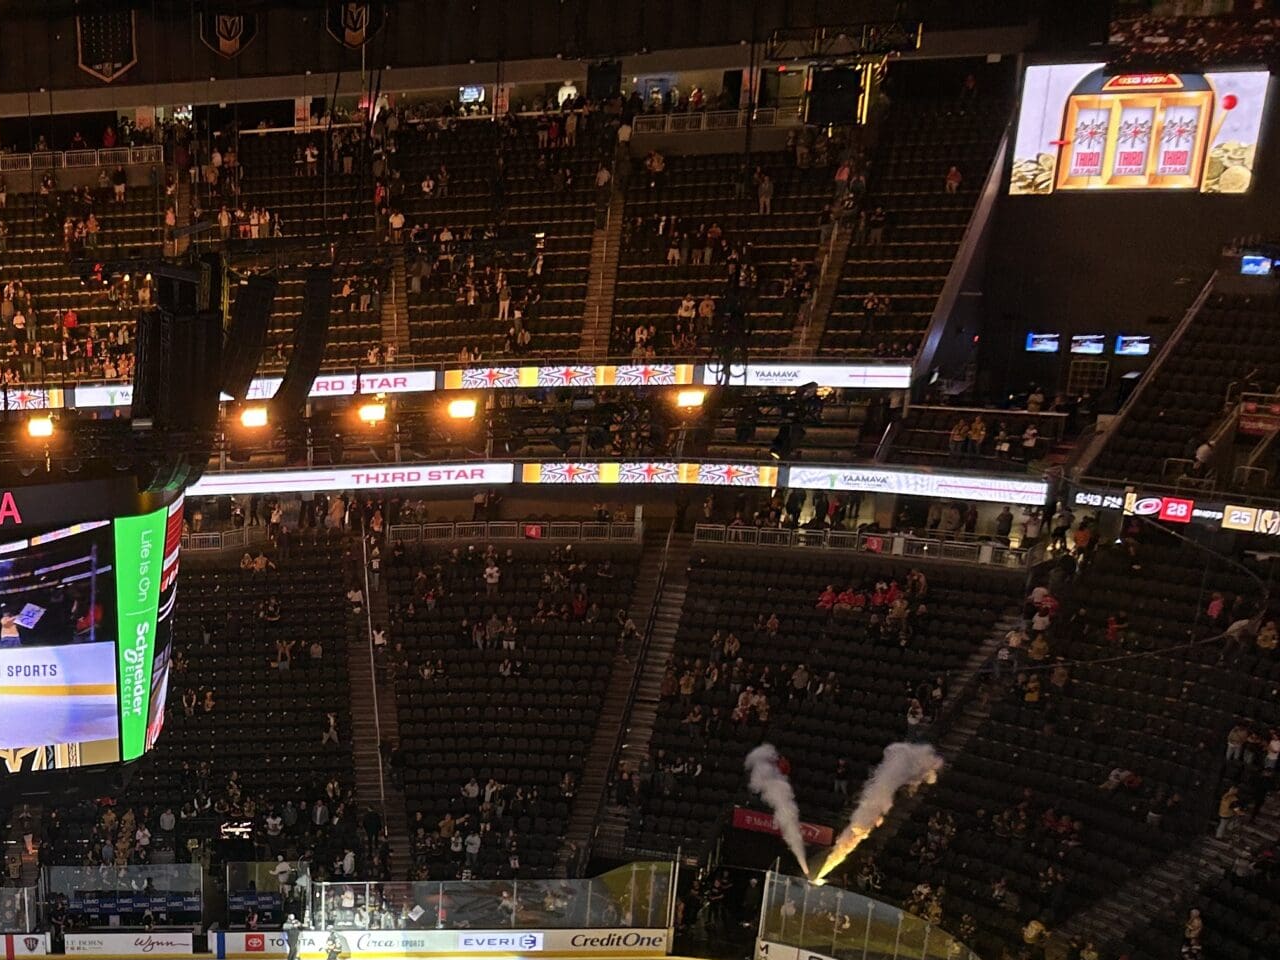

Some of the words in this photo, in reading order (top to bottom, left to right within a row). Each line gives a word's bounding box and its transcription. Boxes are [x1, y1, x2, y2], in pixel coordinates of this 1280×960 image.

[1072, 166, 1099, 174] STAR
[1116, 166, 1141, 174] STAR
[1159, 166, 1185, 174] STAR
[352, 377, 407, 391] STAR
[352, 470, 421, 484] THIRD
[428, 468, 485, 481] STAR
[1166, 502, 1188, 517] 28
[1230, 510, 1251, 524] 25
[7, 664, 58, 678] SPORTS
[132, 621, 150, 718] Schneider
[121, 665, 133, 718] Electric
[463, 938, 515, 946] EVERI
